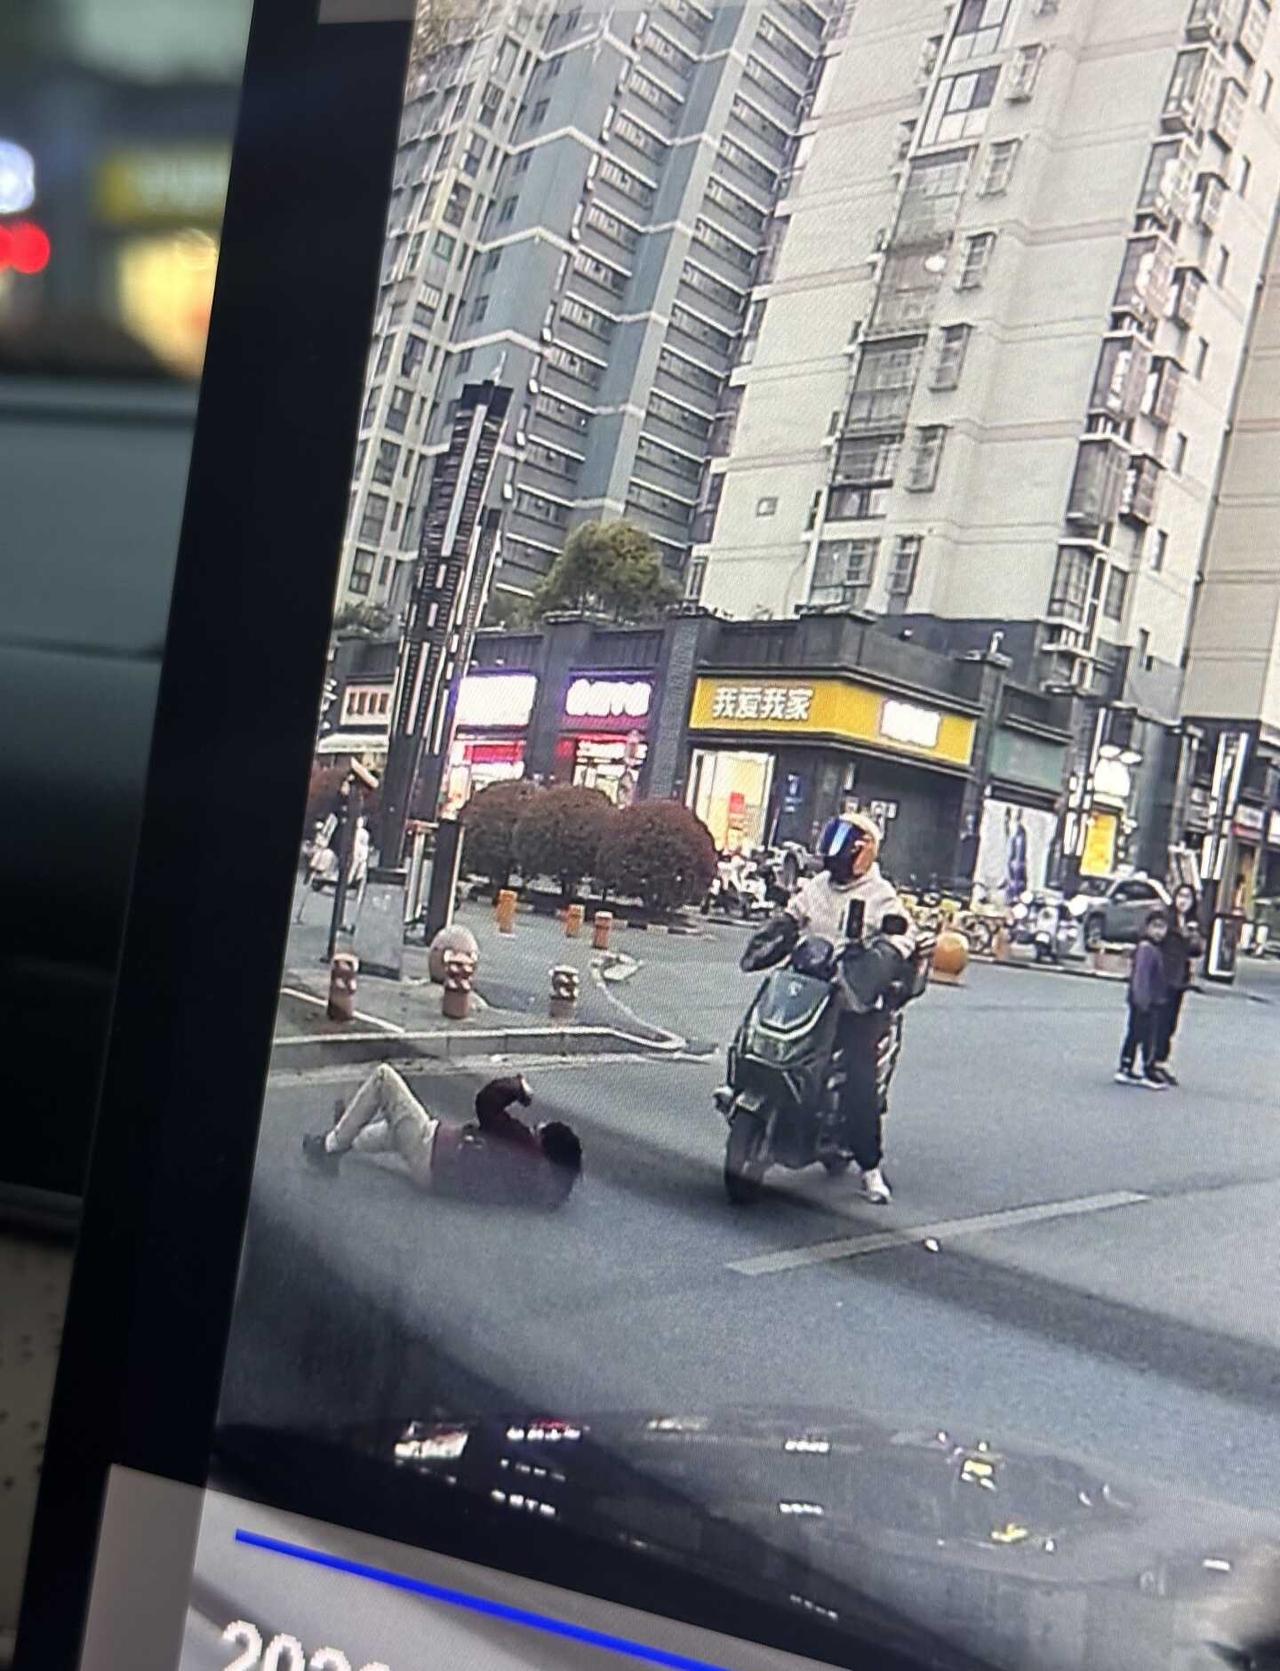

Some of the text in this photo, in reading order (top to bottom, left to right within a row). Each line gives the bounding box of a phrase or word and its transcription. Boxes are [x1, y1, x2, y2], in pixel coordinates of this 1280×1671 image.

[712, 686, 814, 720] 我爱我家
[221, 1619, 390, 1671] 20
